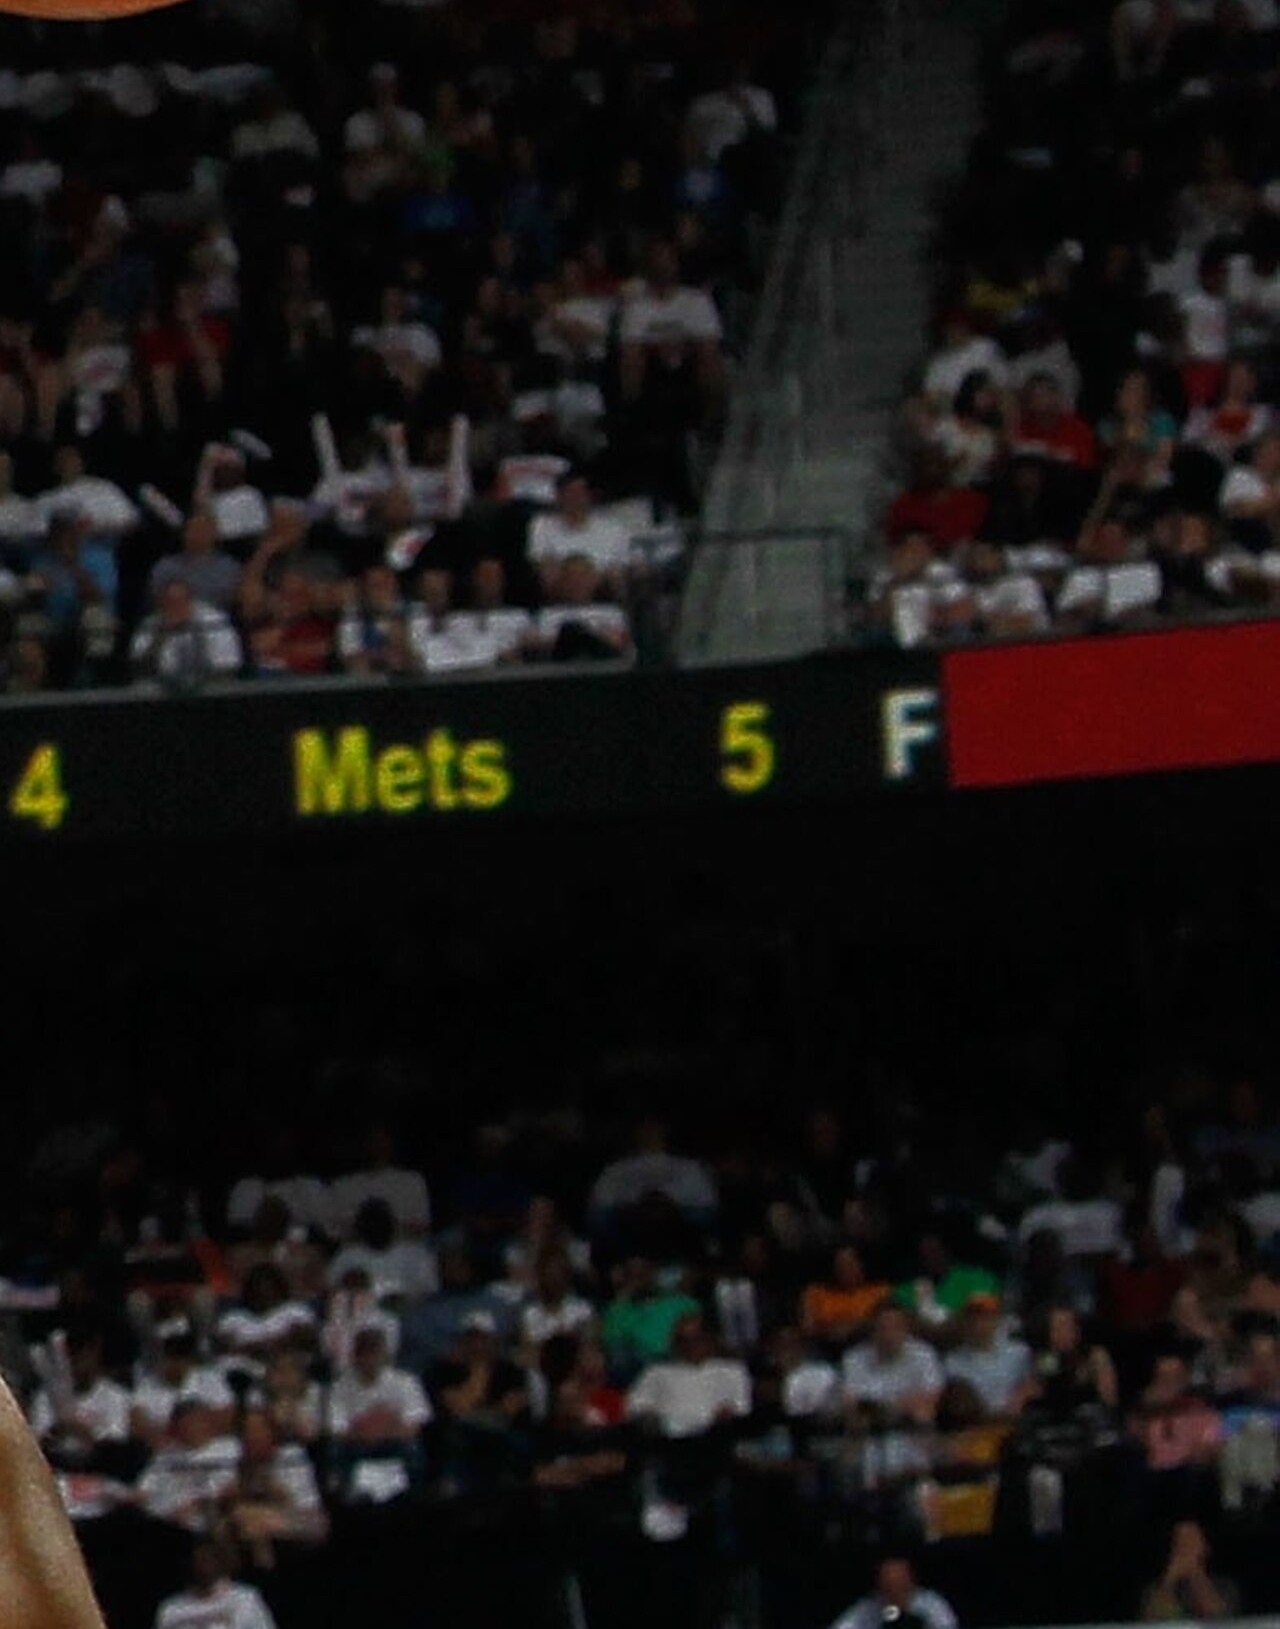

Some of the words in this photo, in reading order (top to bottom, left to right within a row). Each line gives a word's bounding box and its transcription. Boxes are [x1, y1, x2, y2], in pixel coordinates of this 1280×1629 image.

[9, 740, 70, 831] 4
[292, 724, 513, 816] Mets
[719, 700, 776, 795] 5
[880, 688, 938, 780] F
